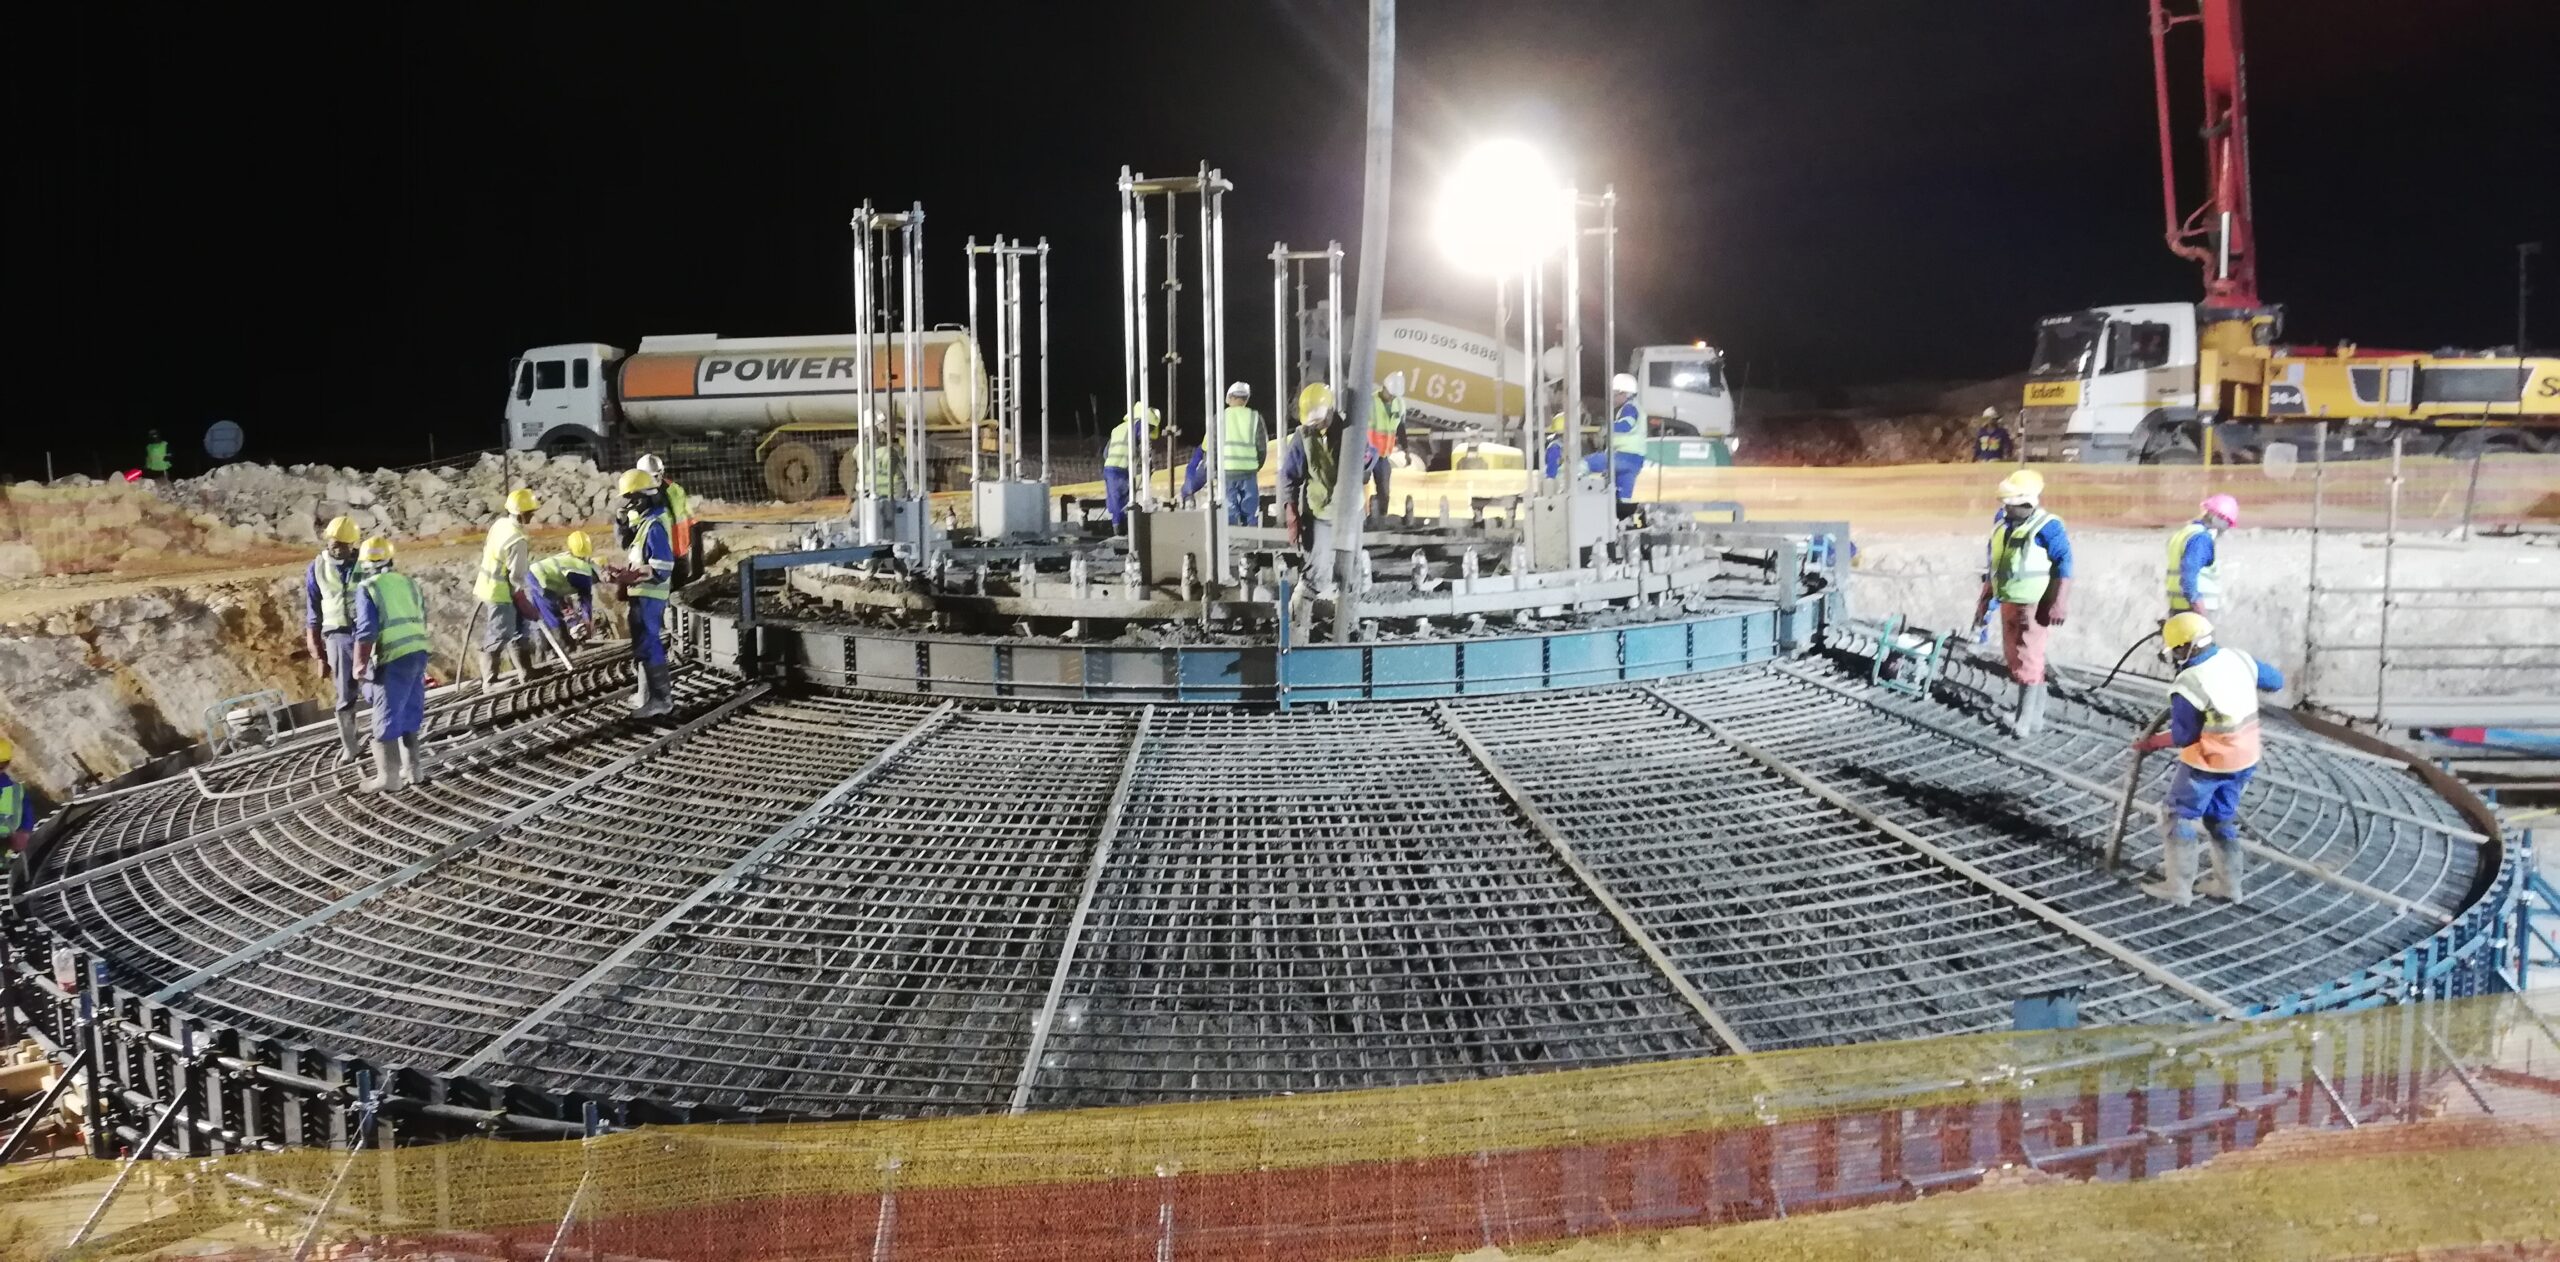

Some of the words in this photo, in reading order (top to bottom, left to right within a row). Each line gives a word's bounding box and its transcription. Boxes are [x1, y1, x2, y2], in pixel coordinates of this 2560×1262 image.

[1393, 327, 1428, 343] (010)
[1430, 334, 1457, 350] 595
[1460, 341, 1498, 361] 4888
[704, 357, 856, 382] POWER
[1409, 367, 1466, 404] 163
[2538, 376, 2560, 398] S
